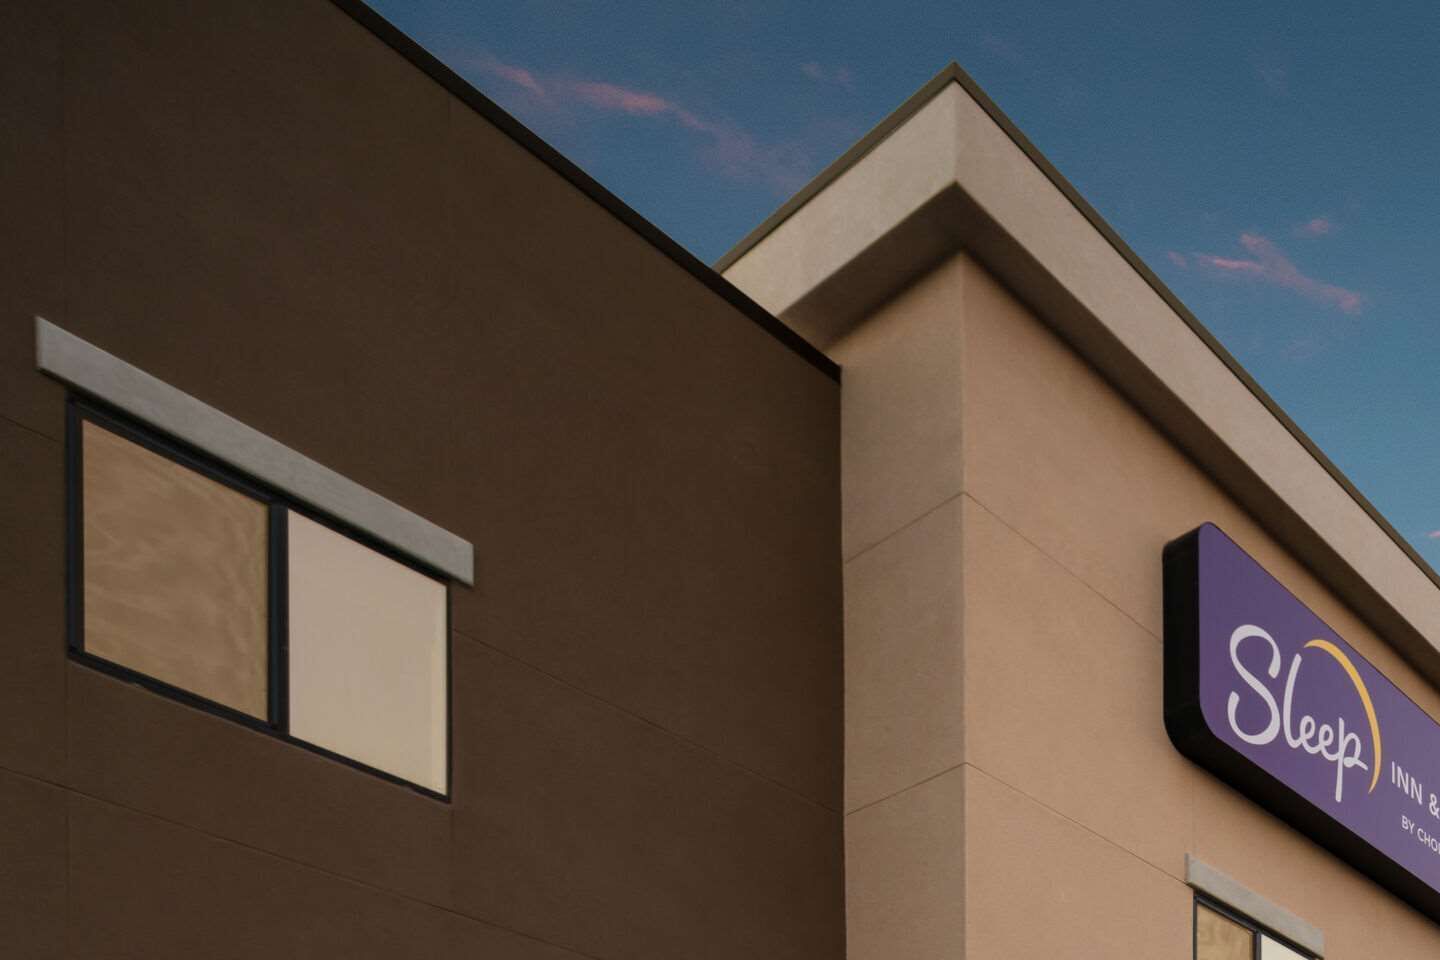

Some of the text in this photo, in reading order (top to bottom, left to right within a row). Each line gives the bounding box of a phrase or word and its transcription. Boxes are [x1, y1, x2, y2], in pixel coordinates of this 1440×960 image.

[1227, 624, 1368, 802] Sleep
[1392, 761, 1422, 805] INN
[1429, 793, 1440, 819] &
[1401, 815, 1415, 834] BY
